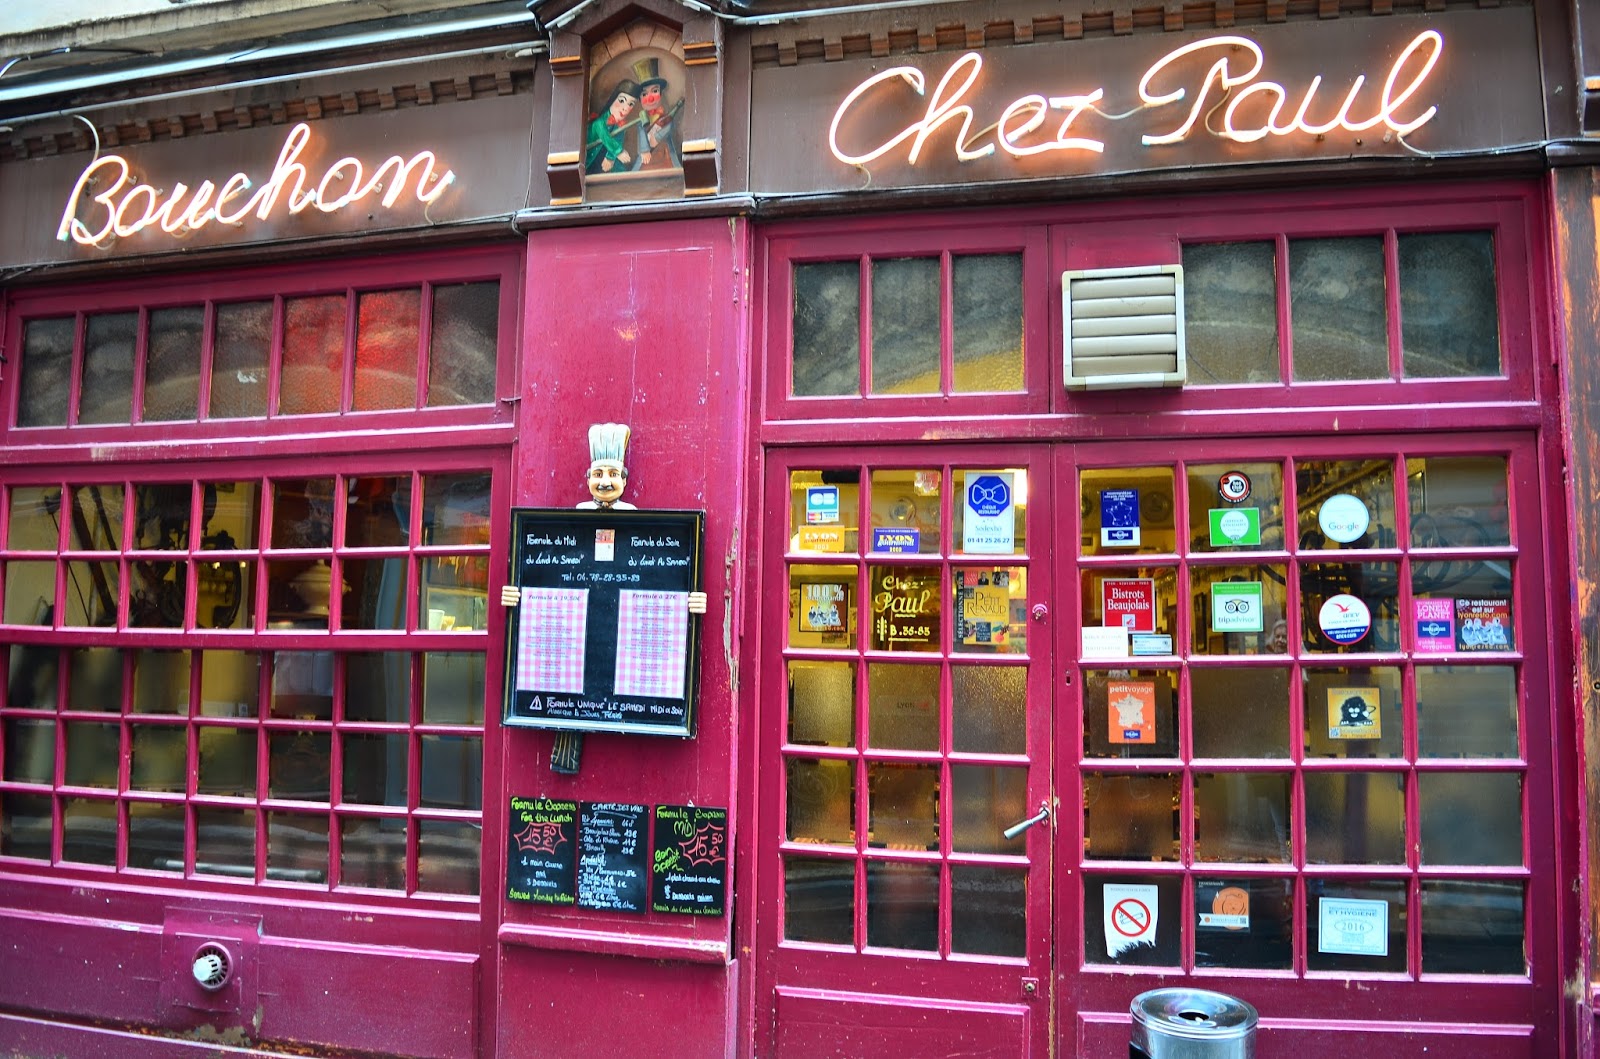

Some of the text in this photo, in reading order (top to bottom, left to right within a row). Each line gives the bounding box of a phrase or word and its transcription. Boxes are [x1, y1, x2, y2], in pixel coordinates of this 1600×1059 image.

[829, 30, 1443, 164] Chez Paul
[57, 123, 456, 245] Bouchon
[1329, 522, 1359, 532] Google
[805, 532, 839, 540] LYON
[878, 534, 913, 542] LYON
[882, 576, 919, 590] Chez
[1112, 588, 1144, 599] Bistrots
[875, 590, 930, 613] Paul
[1108, 599, 1150, 612] Beaujolais
[1417, 604, 1450, 612] LONELY
[1218, 616, 1255, 624] tripadvisor
[1417, 610, 1450, 619] PLANET
[523, 827, 541, 844] 15
[688, 836, 708, 856] 15
[1342, 922, 1365, 931] 2016
